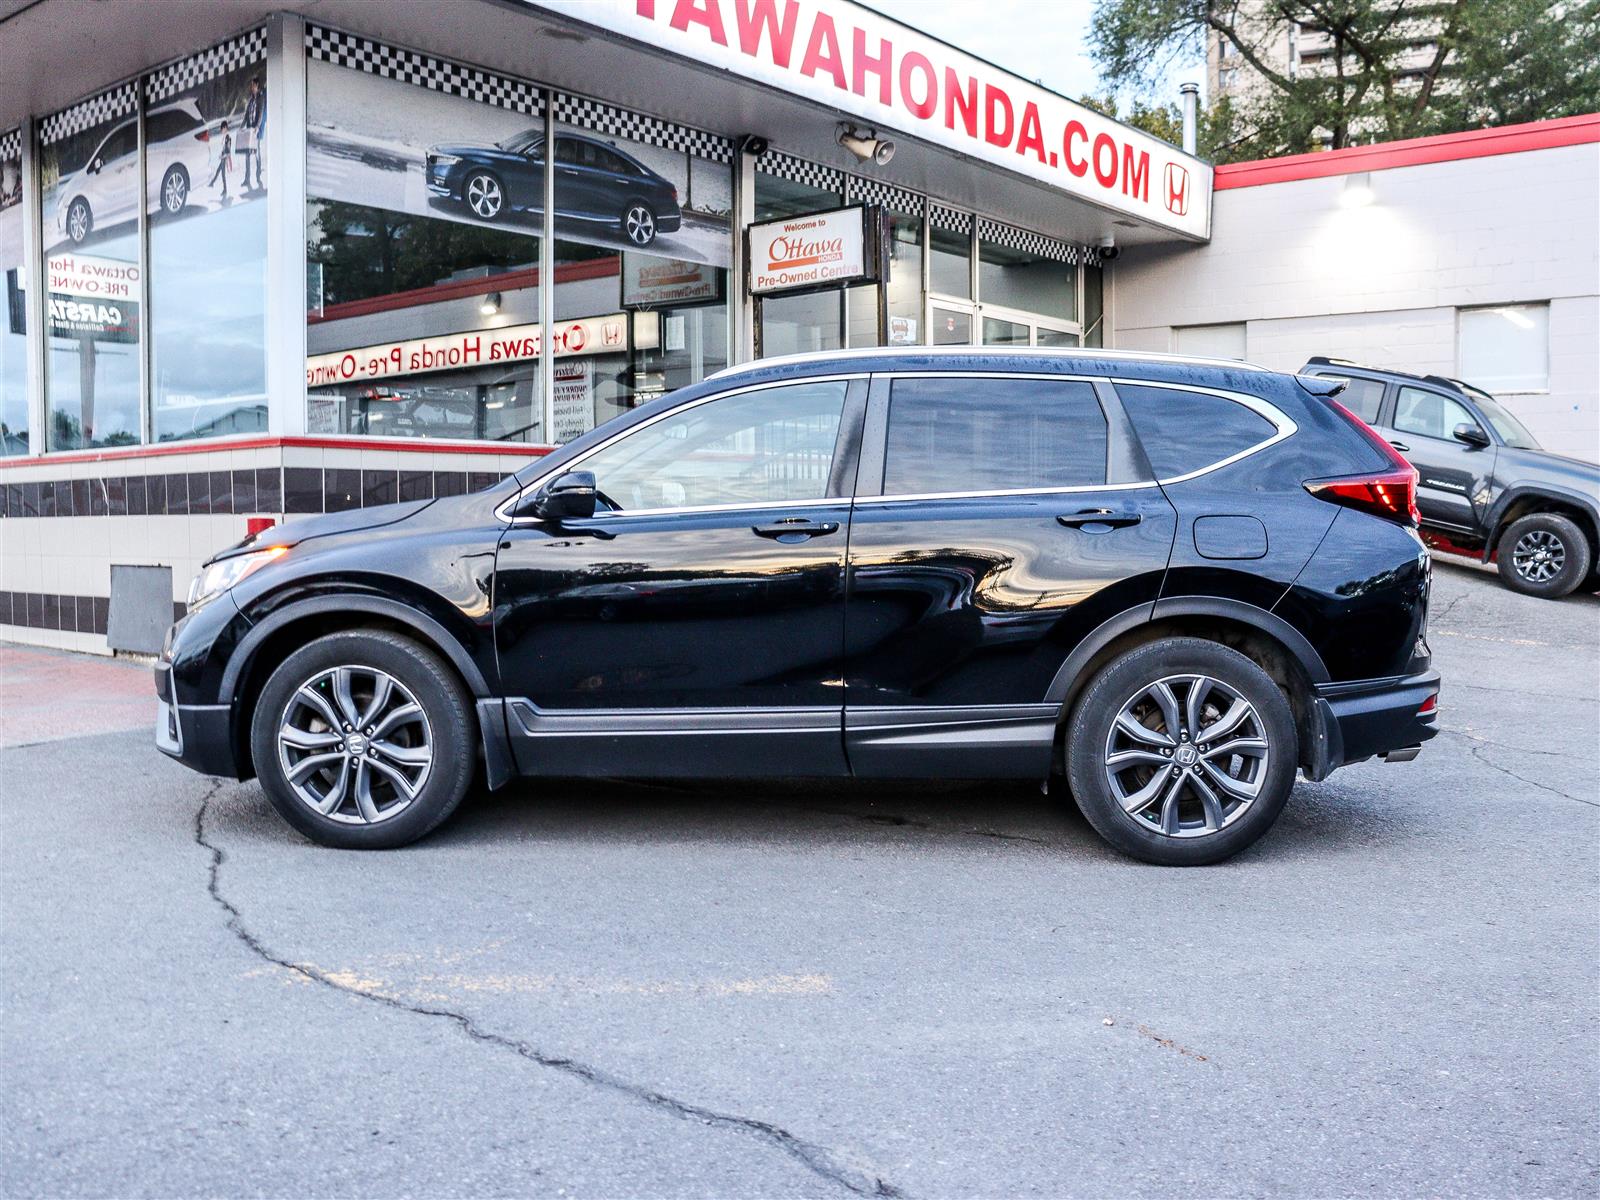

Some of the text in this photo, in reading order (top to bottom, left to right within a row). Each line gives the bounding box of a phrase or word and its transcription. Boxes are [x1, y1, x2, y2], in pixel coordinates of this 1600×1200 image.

[636, 0, 1150, 204] AWAHONDA.COM
[784, 219, 826, 233] Welcome to
[768, 236, 843, 262] Ottawa
[819, 253, 841, 263] HONDA
[757, 264, 859, 288] Pre-Owned Centre
